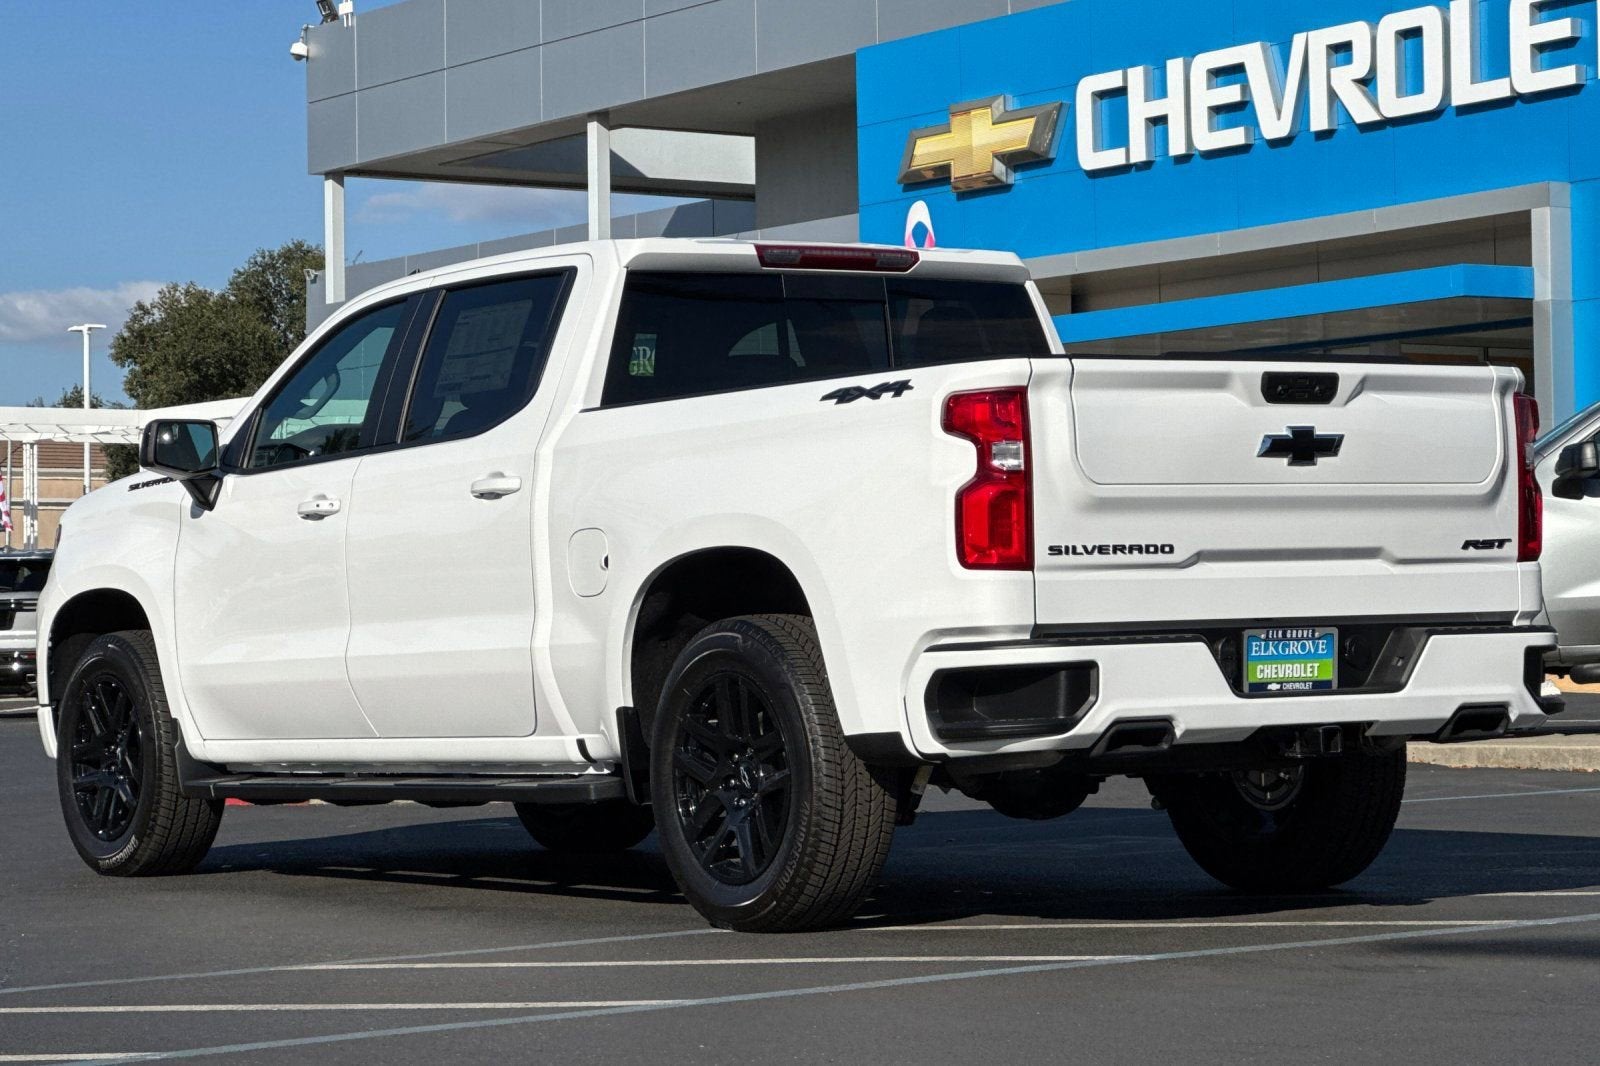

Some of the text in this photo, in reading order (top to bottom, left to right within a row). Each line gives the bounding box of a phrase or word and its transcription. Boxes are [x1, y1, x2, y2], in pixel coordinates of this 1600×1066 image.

[1076, 0, 1600, 171] CHEVROLE
[1047, 543, 1175, 556] SILVERADO
[1461, 538, 1512, 550] RST
[1268, 629, 1313, 639] ELK GROVE
[1256, 663, 1319, 679] CHEVROLET
[1282, 682, 1313, 690] CHEVROLET
